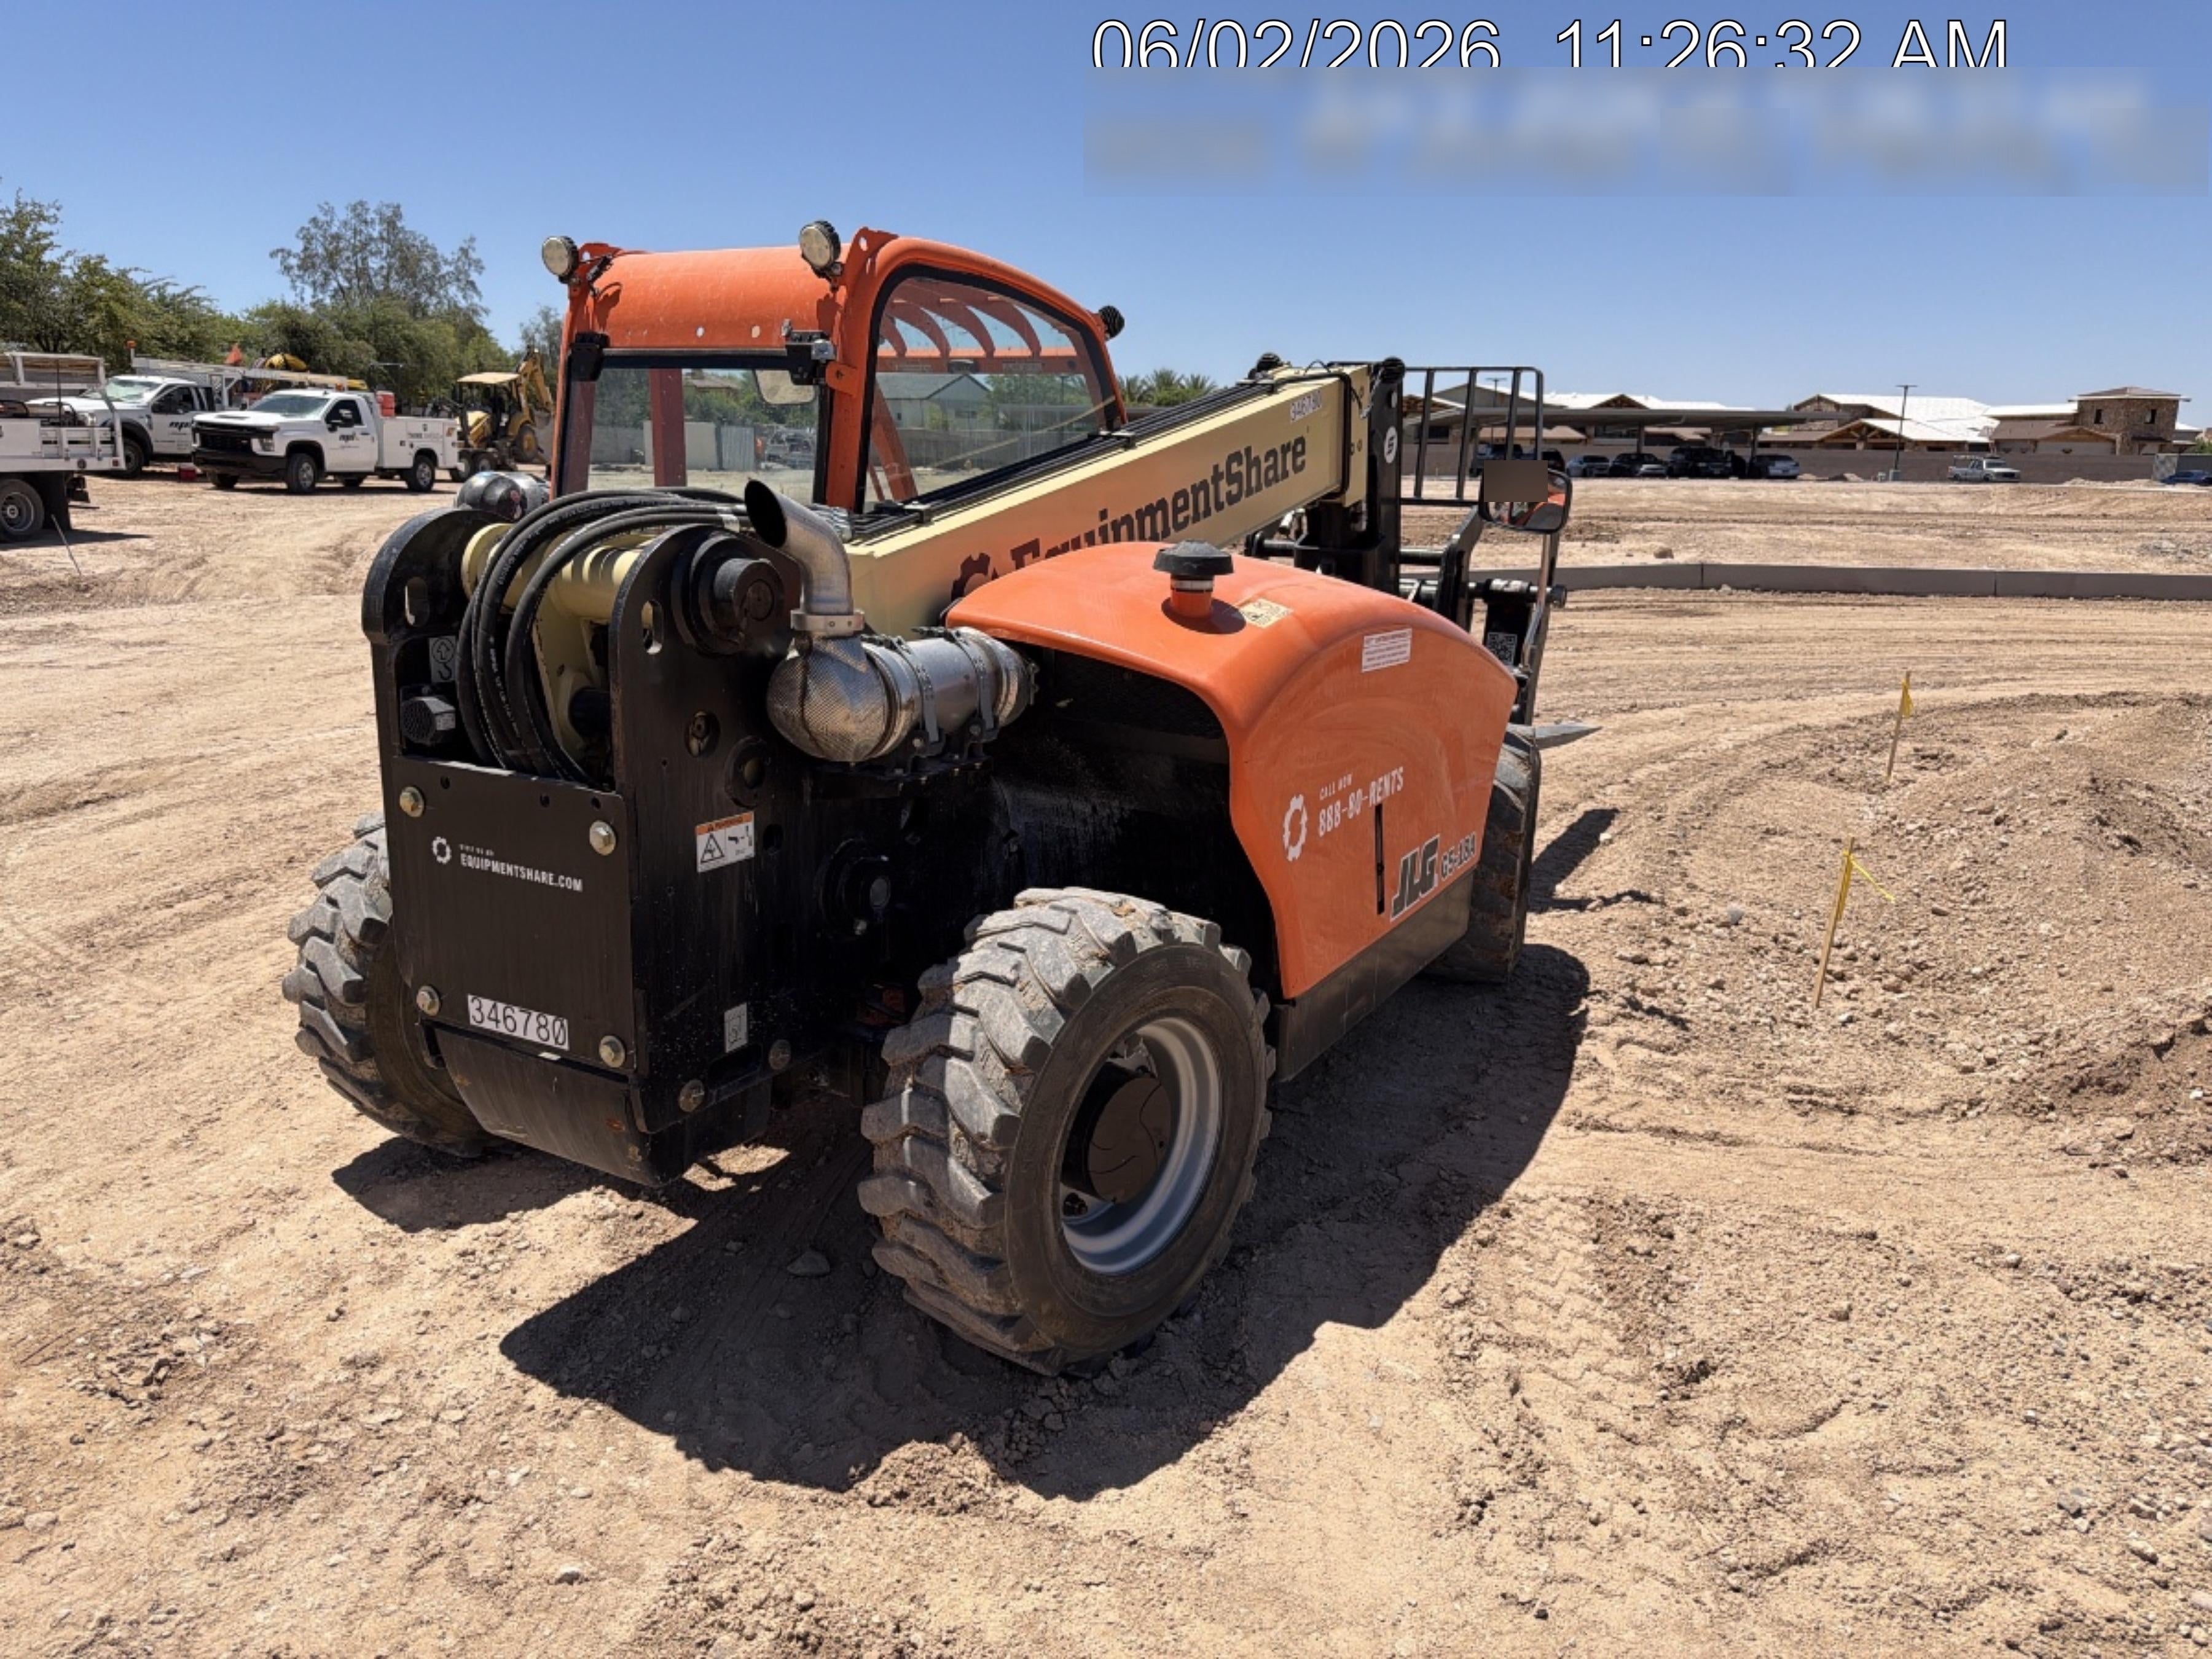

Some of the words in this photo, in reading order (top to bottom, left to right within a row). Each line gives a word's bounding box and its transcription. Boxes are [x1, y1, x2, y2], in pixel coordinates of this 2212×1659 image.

[1010, 435, 1306, 570] imentShare
[460, 853, 583, 892] EQUIPMENTSHARE.COM
[1390, 833, 1440, 922] JLG
[471, 997, 567, 1045] 346780
